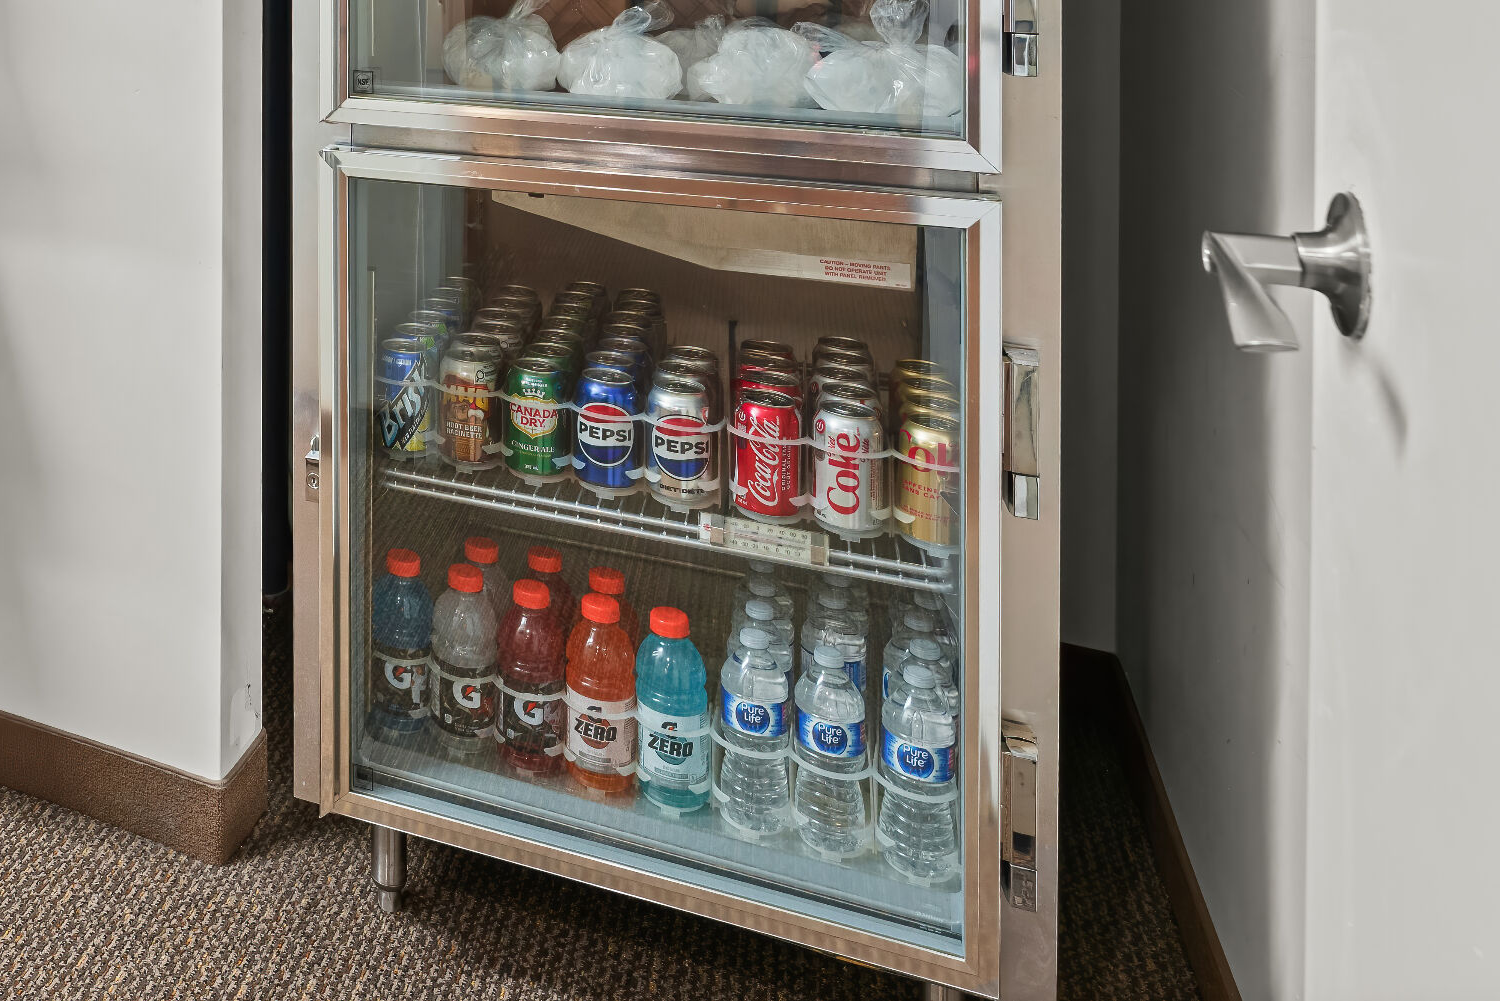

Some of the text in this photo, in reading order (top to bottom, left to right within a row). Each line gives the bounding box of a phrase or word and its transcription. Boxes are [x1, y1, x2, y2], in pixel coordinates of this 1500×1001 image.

[509, 402, 559, 419] CANADA
[446, 421, 483, 433] ROOT BEER
[520, 416, 546, 428] DRY
[446, 427, 483, 440] RACINETTE
[579, 421, 632, 443] PEPSI
[511, 439, 555, 454] GINGER ALE
[654, 434, 710, 456] PEPSI
[827, 432, 861, 515] Coke
[384, 660, 412, 690] G
[452, 680, 481, 709] G
[513, 698, 544, 726] G
[741, 702, 765, 716] Pure
[743, 712, 762, 724] Life
[574, 717, 618, 742] ZERO
[817, 724, 842, 737] Pure
[647, 732, 694, 758] ZERO
[821, 733, 840, 744] Life
[902, 744, 929, 759] Pure
[906, 754, 925, 767] Life
